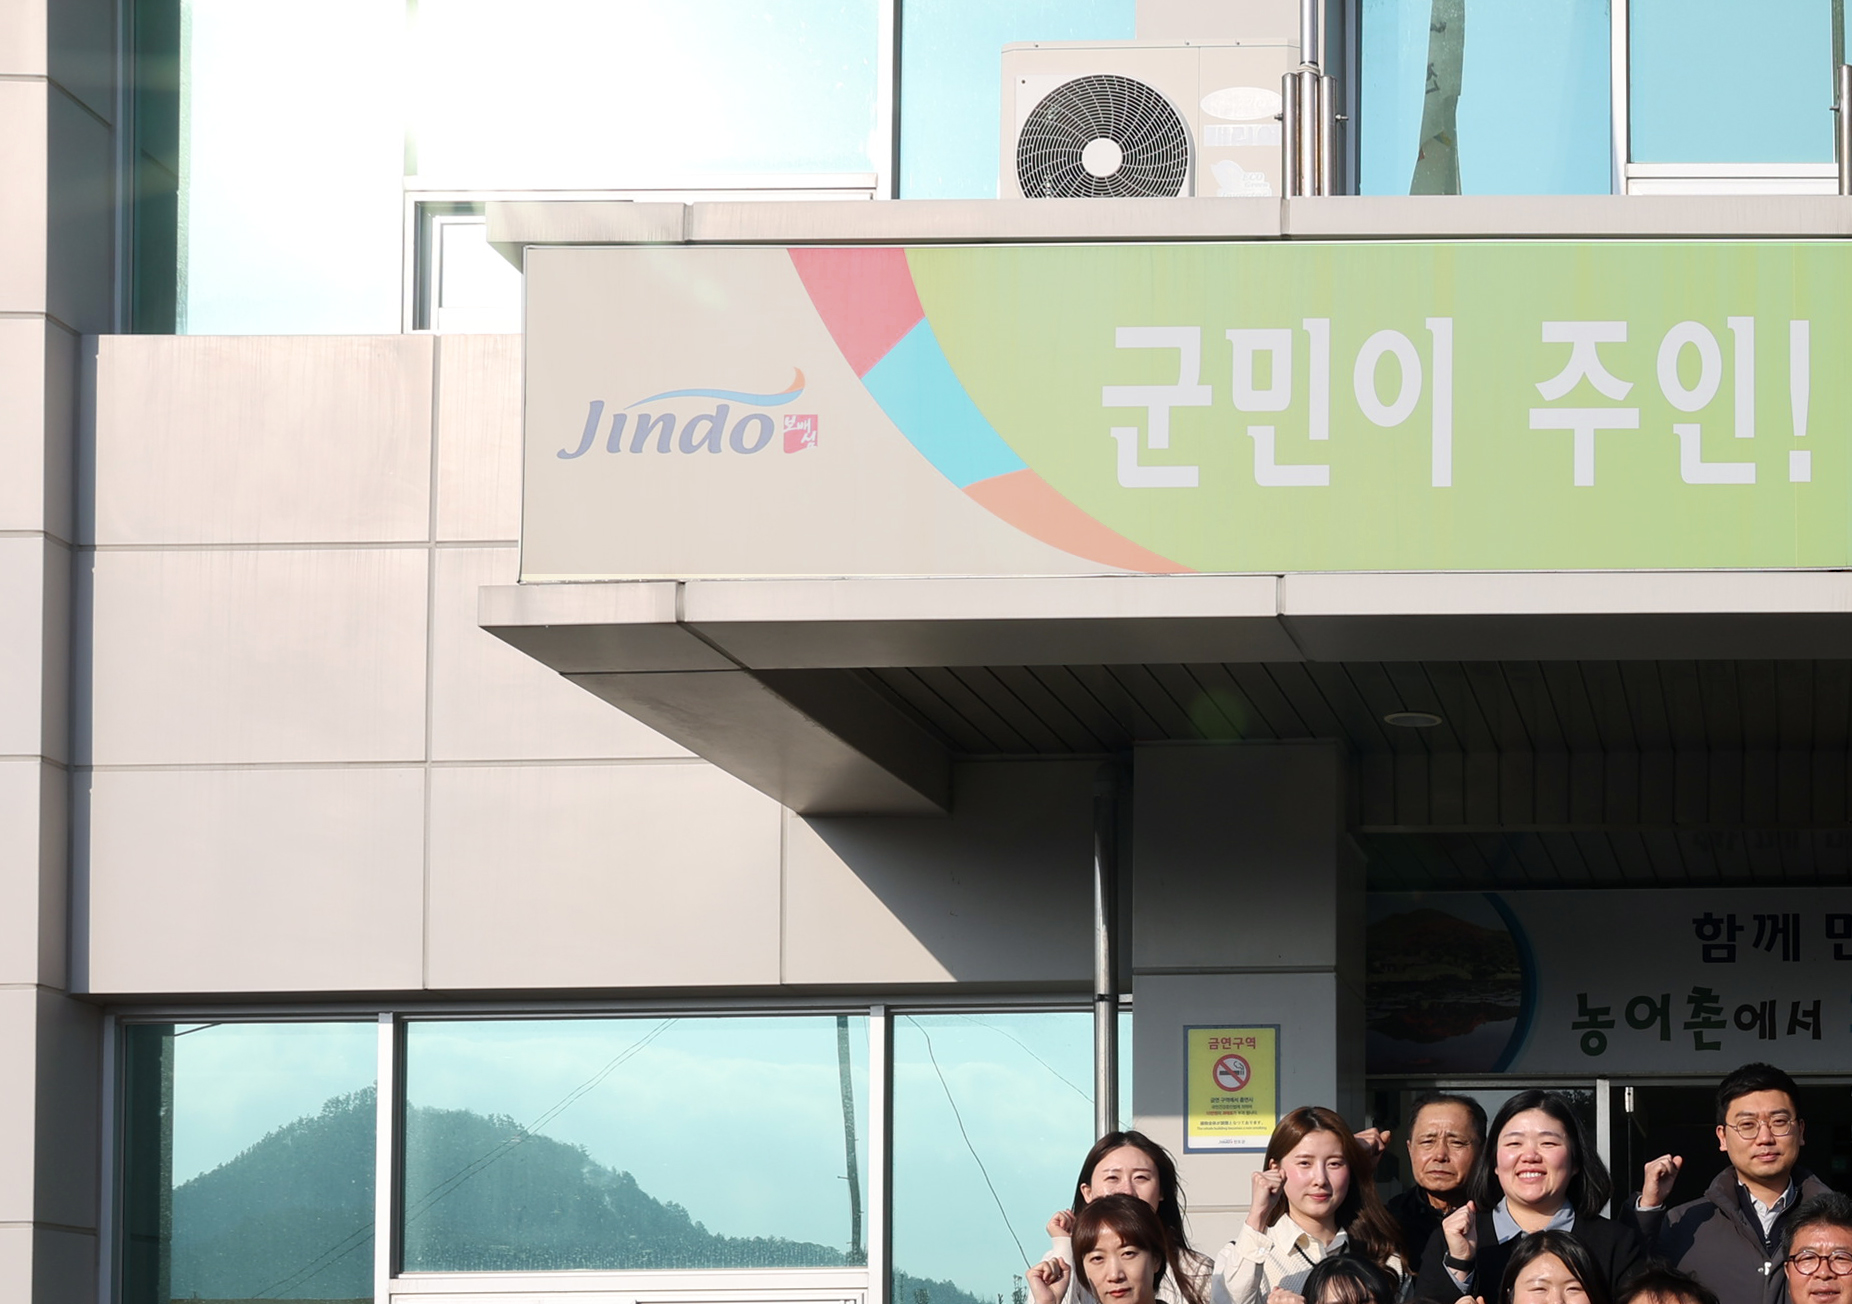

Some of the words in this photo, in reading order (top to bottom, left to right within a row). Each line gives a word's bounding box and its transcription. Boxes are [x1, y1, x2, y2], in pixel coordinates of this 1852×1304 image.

[556, 399, 775, 460] Jindo
[1101, 317, 1453, 488] 군민이
[1529, 316, 1811, 486] 주인!
[1692, 911, 1800, 963] 함께
[1208, 1037, 1257, 1050] 금연구역
[1571, 986, 1822, 1056] 농어촌에서
